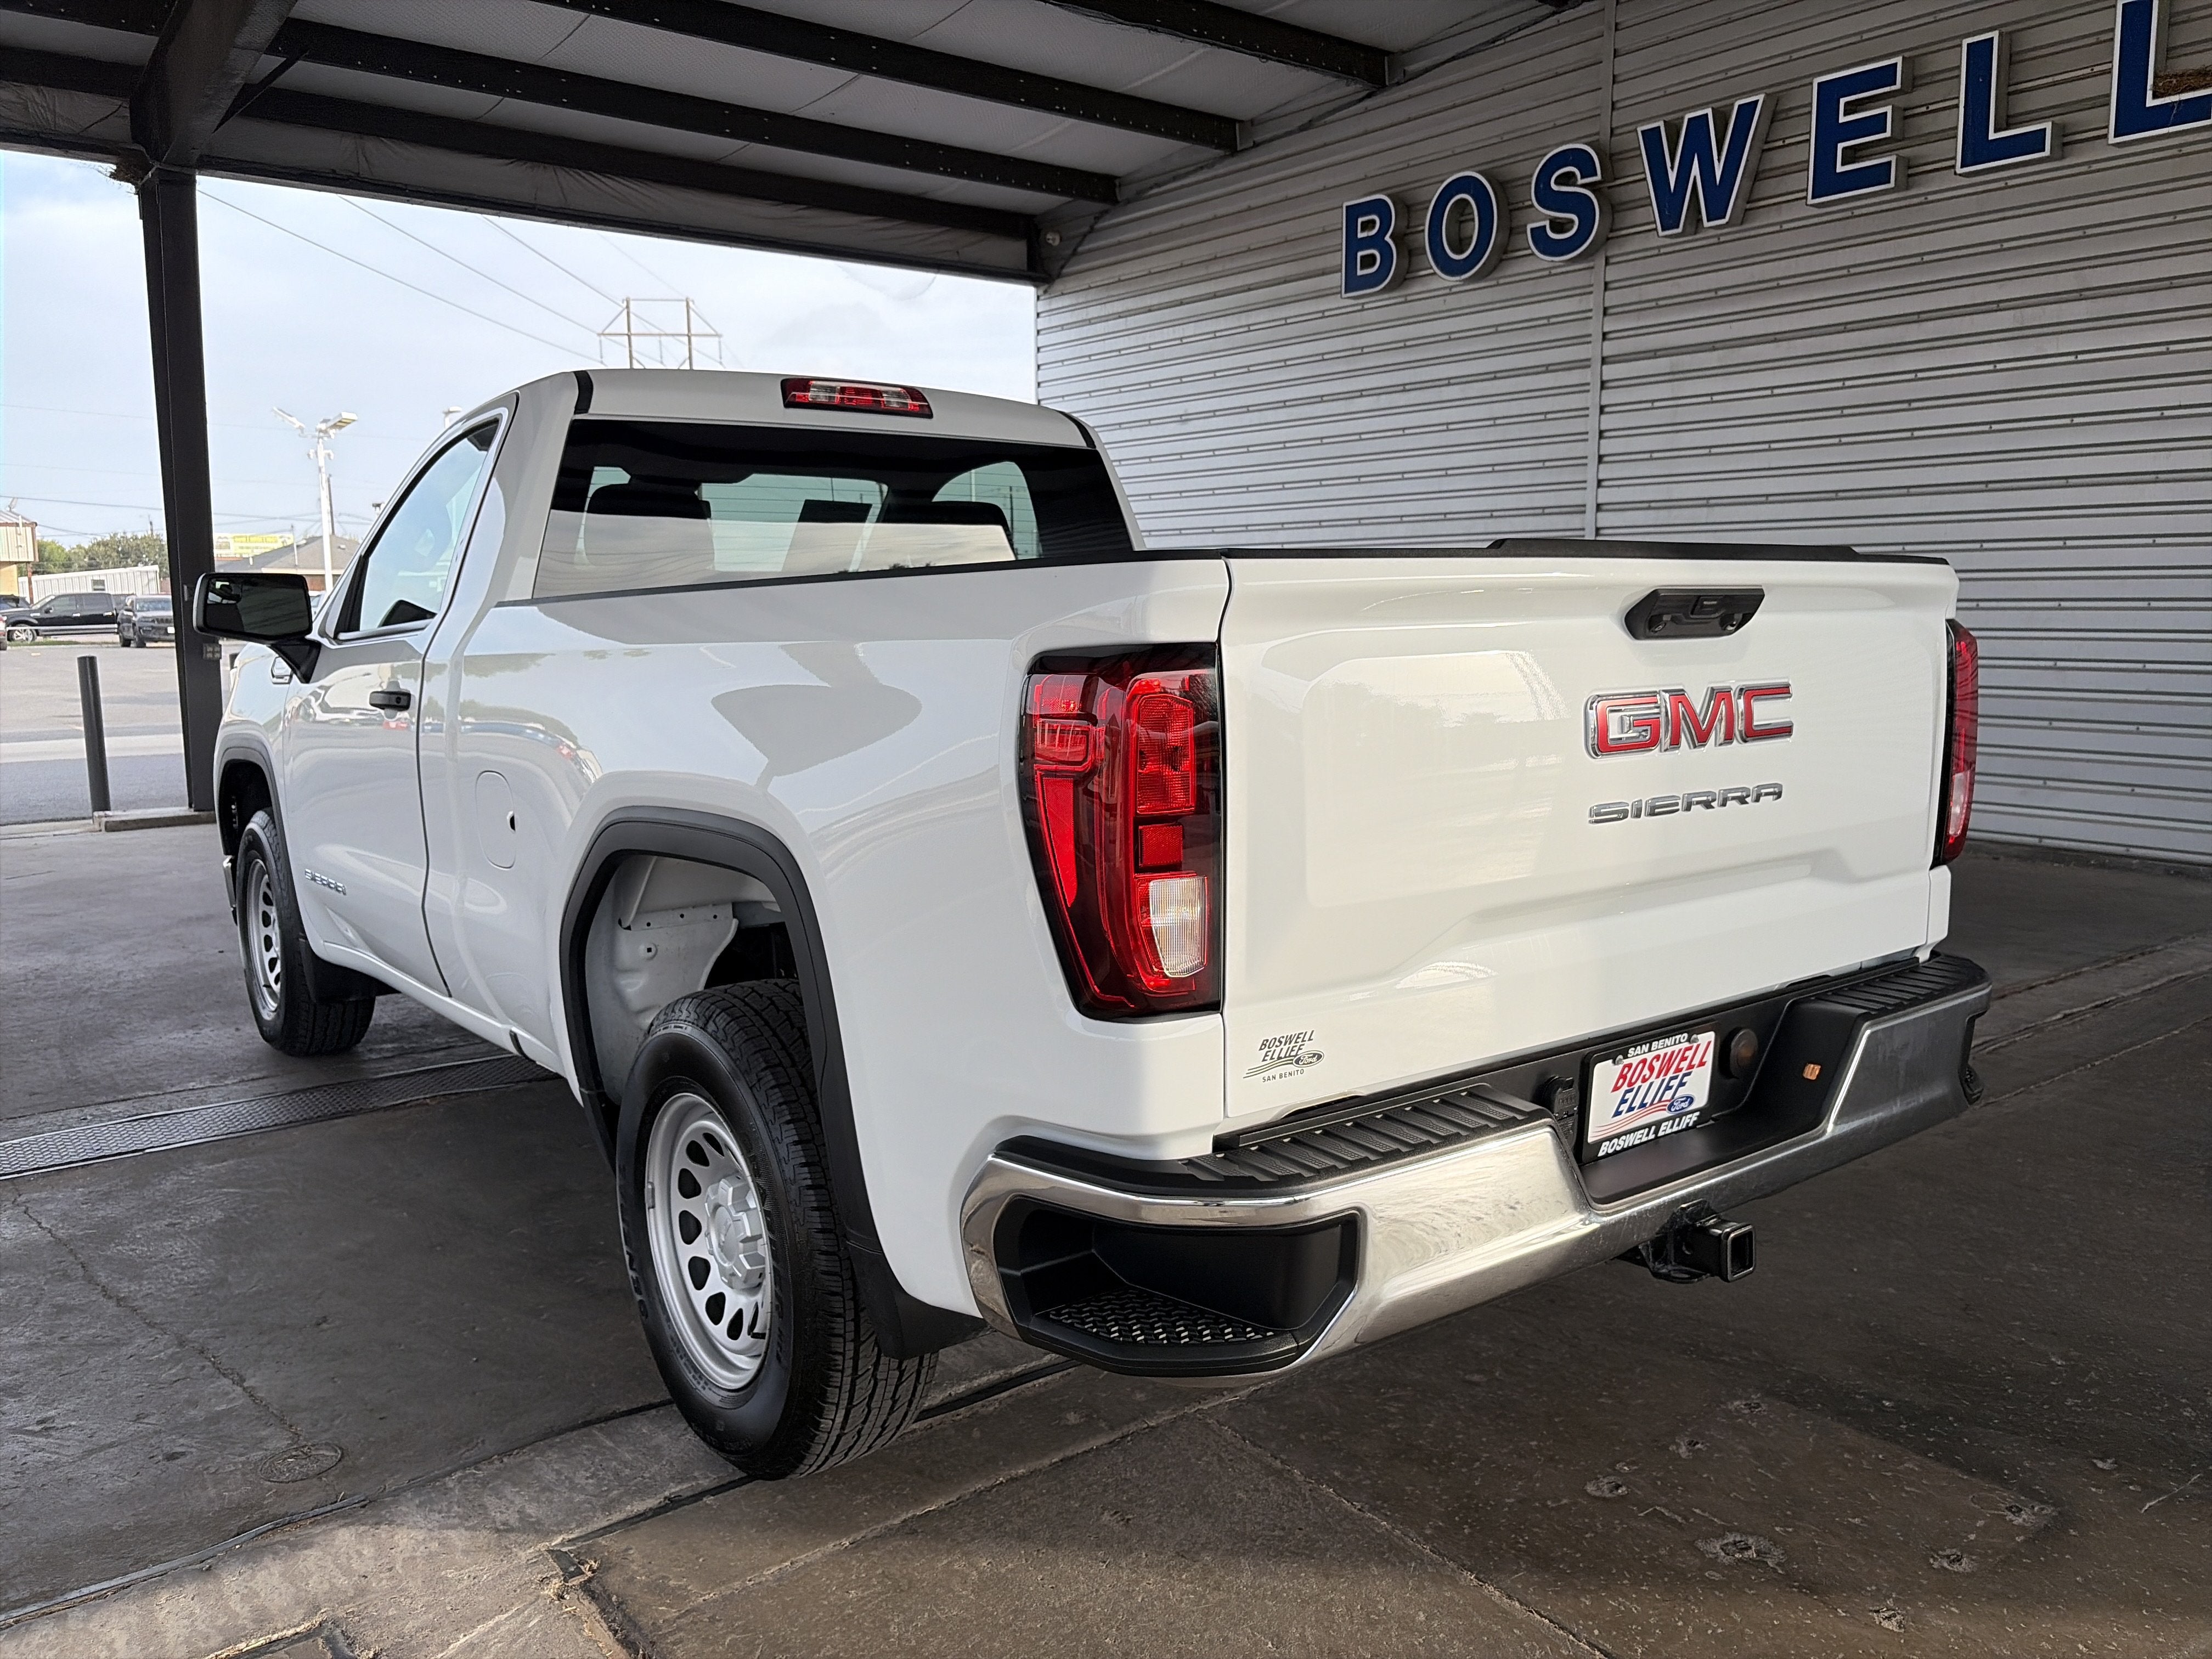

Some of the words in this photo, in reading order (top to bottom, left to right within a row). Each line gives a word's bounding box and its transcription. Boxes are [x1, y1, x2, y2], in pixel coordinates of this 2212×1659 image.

[1341, 0, 2212, 298] BOSWELL
[1584, 681, 1793, 759] GMC
[1588, 783, 1783, 824] SIERRA
[1259, 1030, 1314, 1051] BOSWELL
[1261, 1043, 1305, 1062] ELLIFF
[1627, 1043, 1649, 1057] SAN
[1651, 1033, 1688, 1051] BENITO
[1299, 1054, 1318, 1065] Ford
[1611, 1040, 1712, 1093] BOSWELL
[1262, 1074, 1276, 1083] SAN
[1279, 1069, 1304, 1079] BENITO
[1611, 1071, 1692, 1118] ELLIFF
[1671, 1097, 1690, 1111] Ford
[1598, 1125, 1656, 1157] BOSWELL
[1657, 1111, 1700, 1137] ELLIFF
